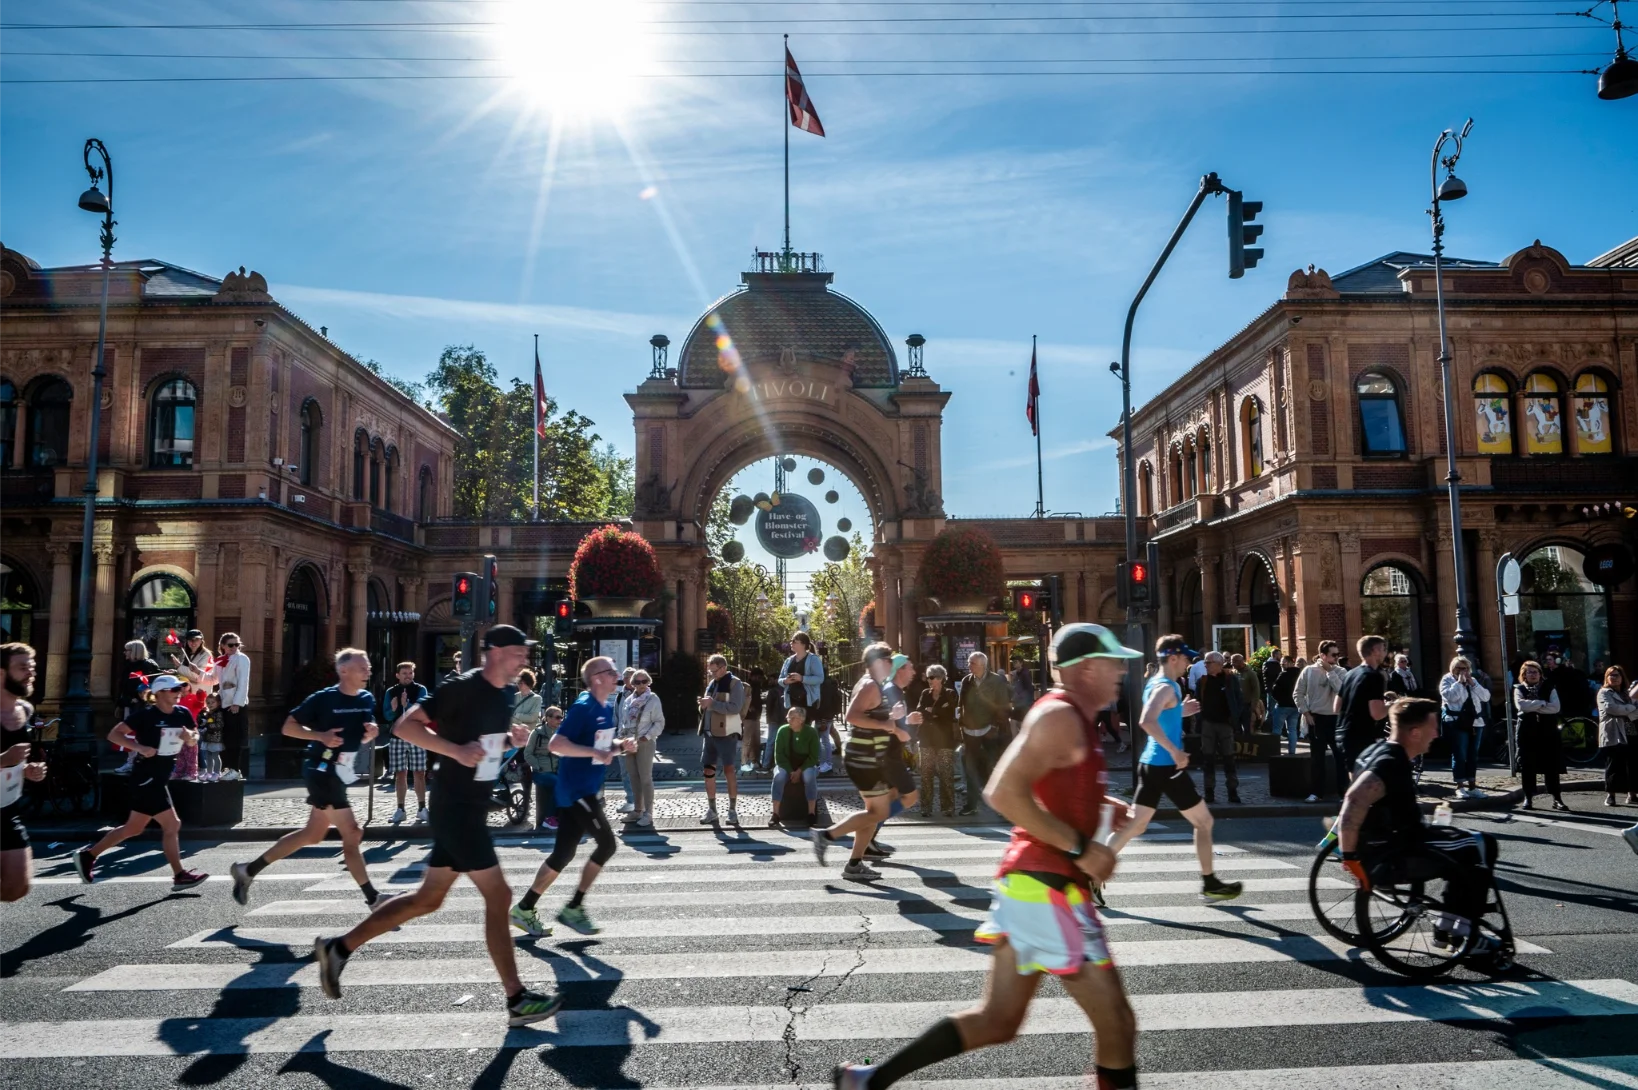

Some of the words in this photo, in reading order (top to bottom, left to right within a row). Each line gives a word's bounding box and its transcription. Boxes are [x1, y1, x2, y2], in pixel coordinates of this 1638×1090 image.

[757, 252, 817, 273] TIVOLI
[751, 380, 828, 401] TIVOLI
[768, 512, 794, 521] Have-
[795, 513, 808, 522] og
[770, 531, 805, 539] festival
[1599, 559, 1614, 570] LEGO
